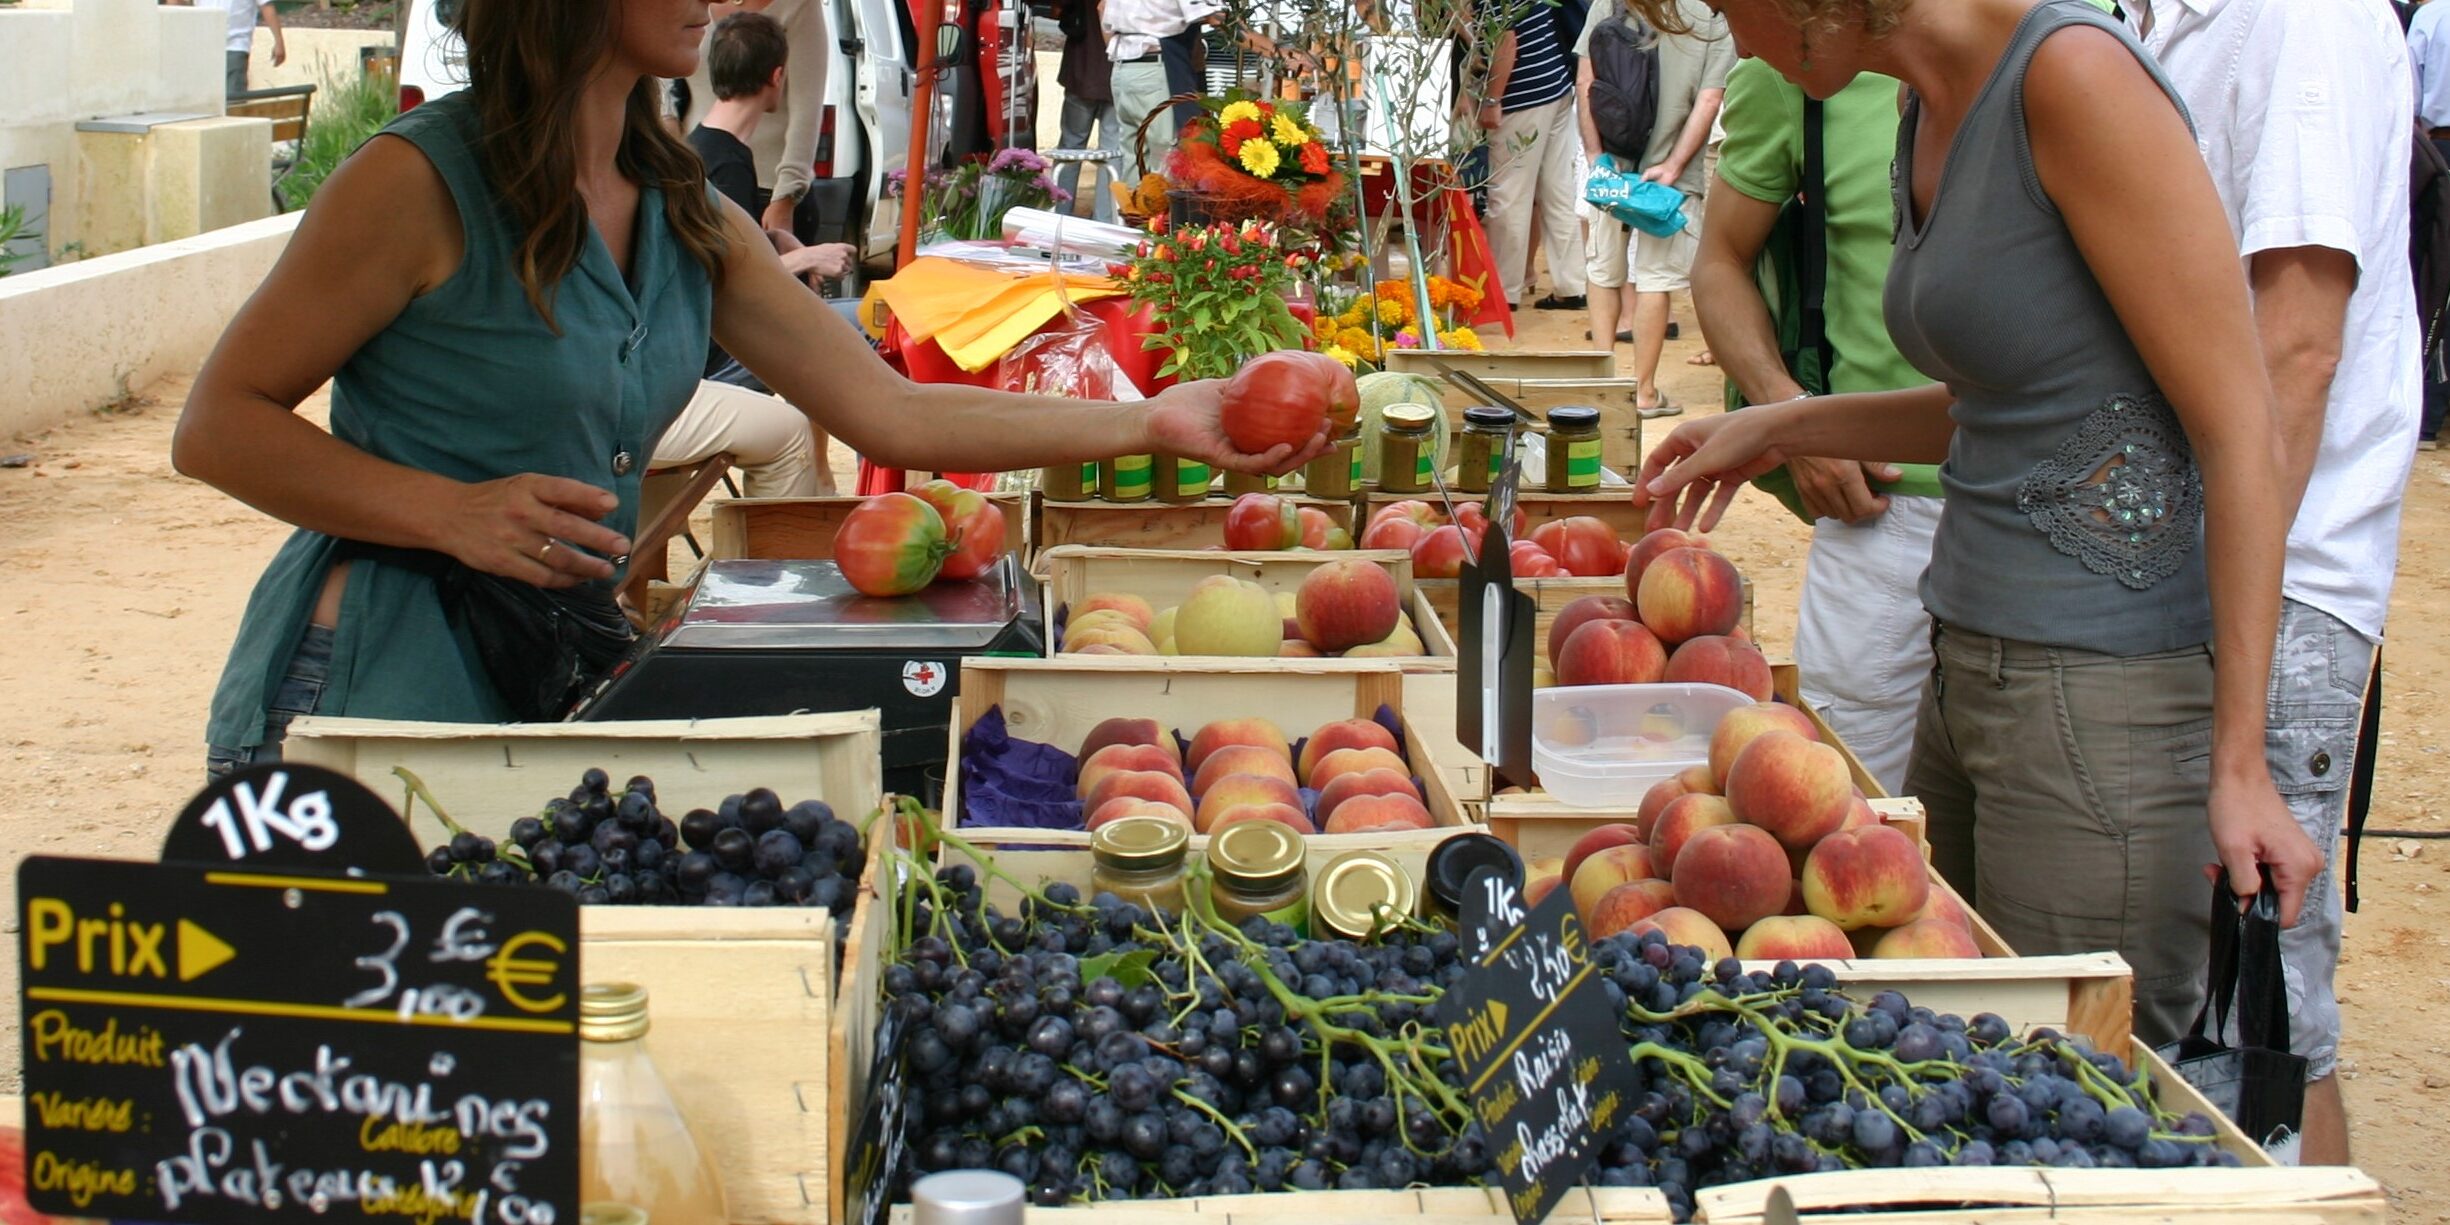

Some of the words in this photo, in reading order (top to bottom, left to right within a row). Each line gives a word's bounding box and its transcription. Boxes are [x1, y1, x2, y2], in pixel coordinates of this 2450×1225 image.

[201, 771, 339, 860] 1Kg
[28, 897, 166, 979] Prix
[486, 930, 567, 1014] €
[1448, 1007, 1498, 1076] Prix
[1561, 912, 1588, 964] €
[30, 1009, 166, 1067] Produit
[1514, 1029, 1572, 1099] Raisin
[32, 1151, 137, 1208] Origine
